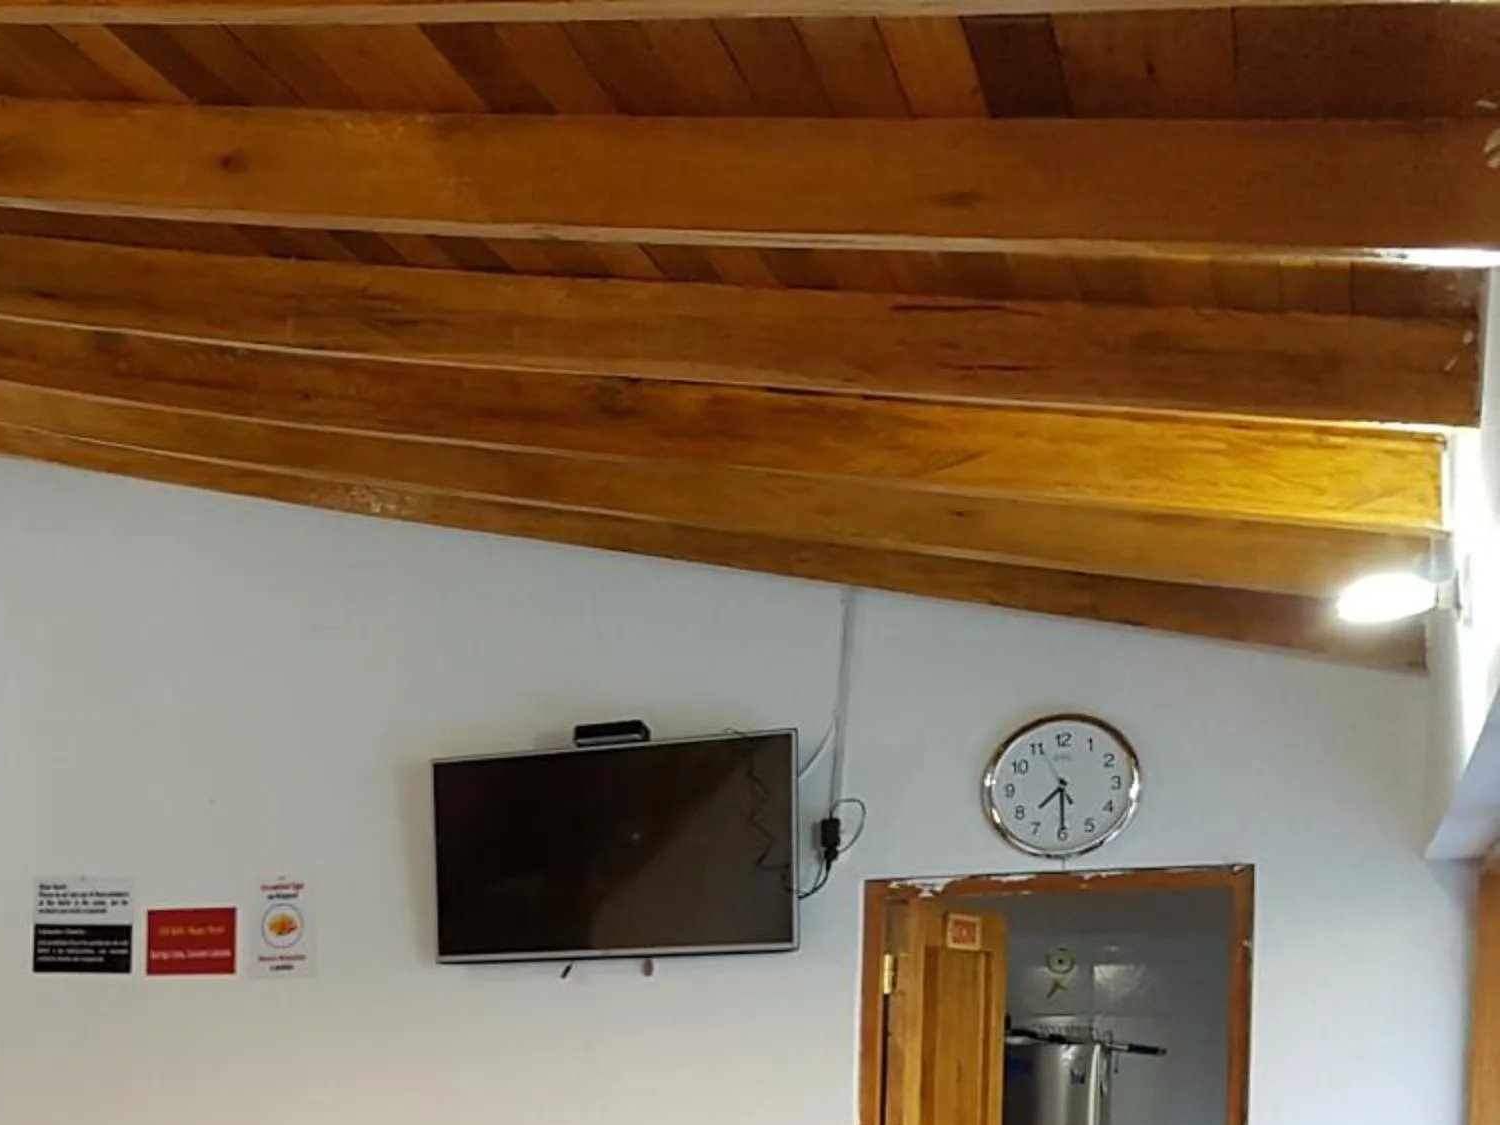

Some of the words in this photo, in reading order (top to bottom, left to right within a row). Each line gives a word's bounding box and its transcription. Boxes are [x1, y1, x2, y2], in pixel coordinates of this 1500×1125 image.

[1055, 732, 1073, 748] 12
[1029, 742, 1045, 756] 11
[1011, 759, 1029, 774] 10
[1103, 753, 1115, 768] 2
[1110, 775, 1122, 790] 3
[1004, 783, 1015, 799] 9
[1014, 805, 1026, 821] 8
[1102, 800, 1114, 813] 4
[1030, 822, 1041, 836] 7
[1057, 825, 1069, 841] 6
[1084, 818, 1096, 833] 5
